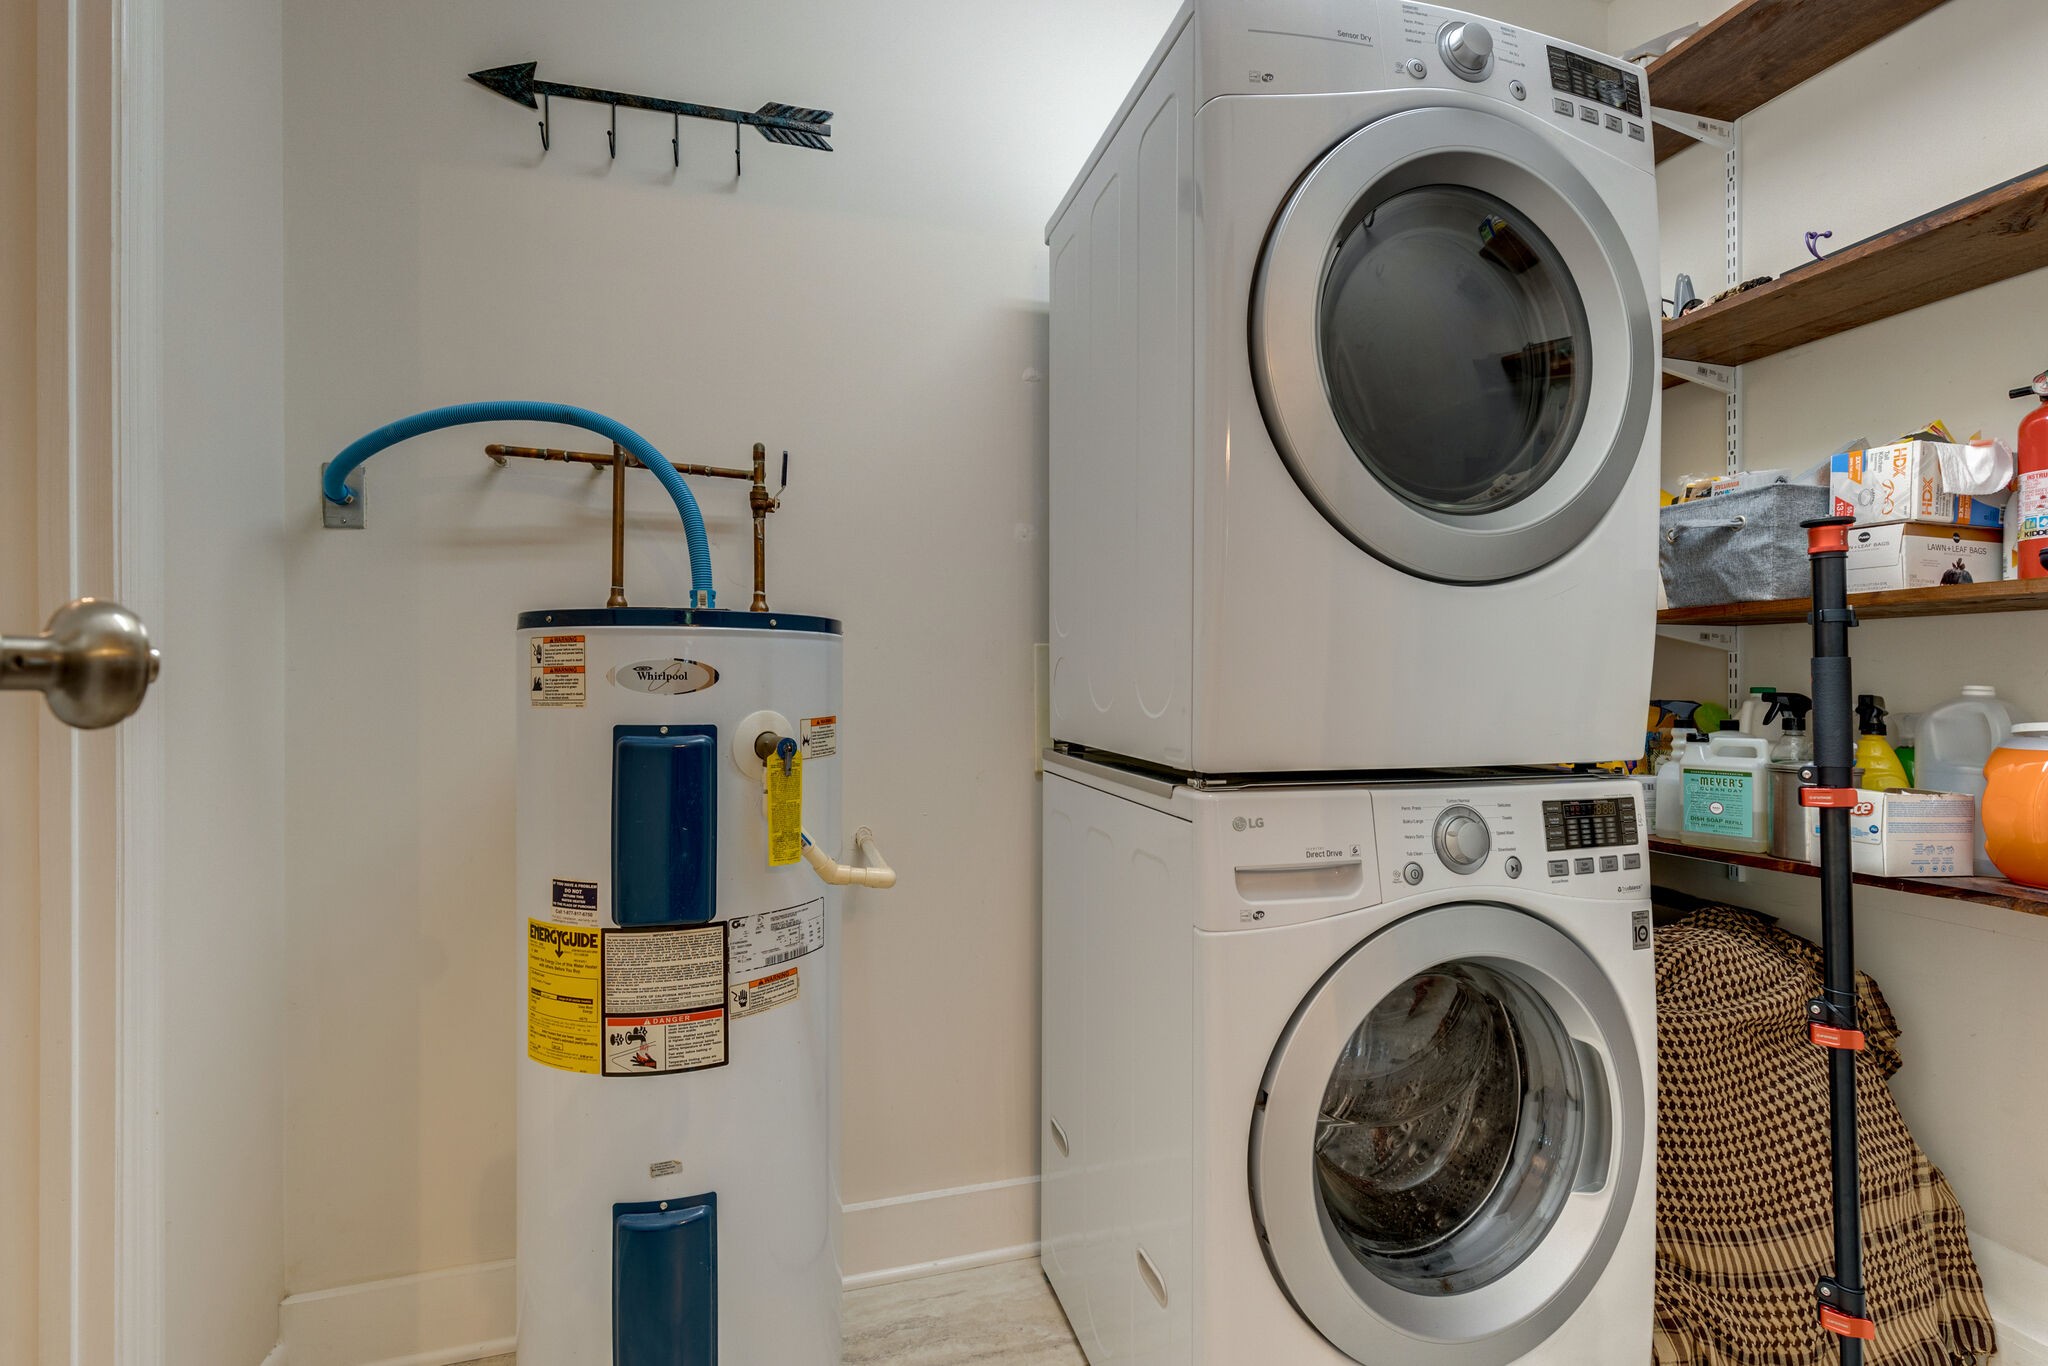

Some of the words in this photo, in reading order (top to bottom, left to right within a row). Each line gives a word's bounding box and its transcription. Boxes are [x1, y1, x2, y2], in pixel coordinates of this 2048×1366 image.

[1337, 30, 1359, 39] Sensor
[1361, 33, 1371, 42] Dry
[1893, 447, 1907, 478] HDX
[1714, 481, 1739, 491] SYLVANIA
[1922, 477, 1934, 515] HDX
[1836, 502, 1844, 511] 13
[1969, 547, 1987, 555] BAGS
[637, 672, 688, 683] Whirlpool
[1700, 777, 1743, 788] MEYER'S
[1248, 818, 1264, 829] LG
[530, 924, 598, 948] ENERGYGUIDE
[1635, 925, 1648, 943] 10
[764, 970, 790, 983] WARNING
[653, 1016, 690, 1024] DANGER
